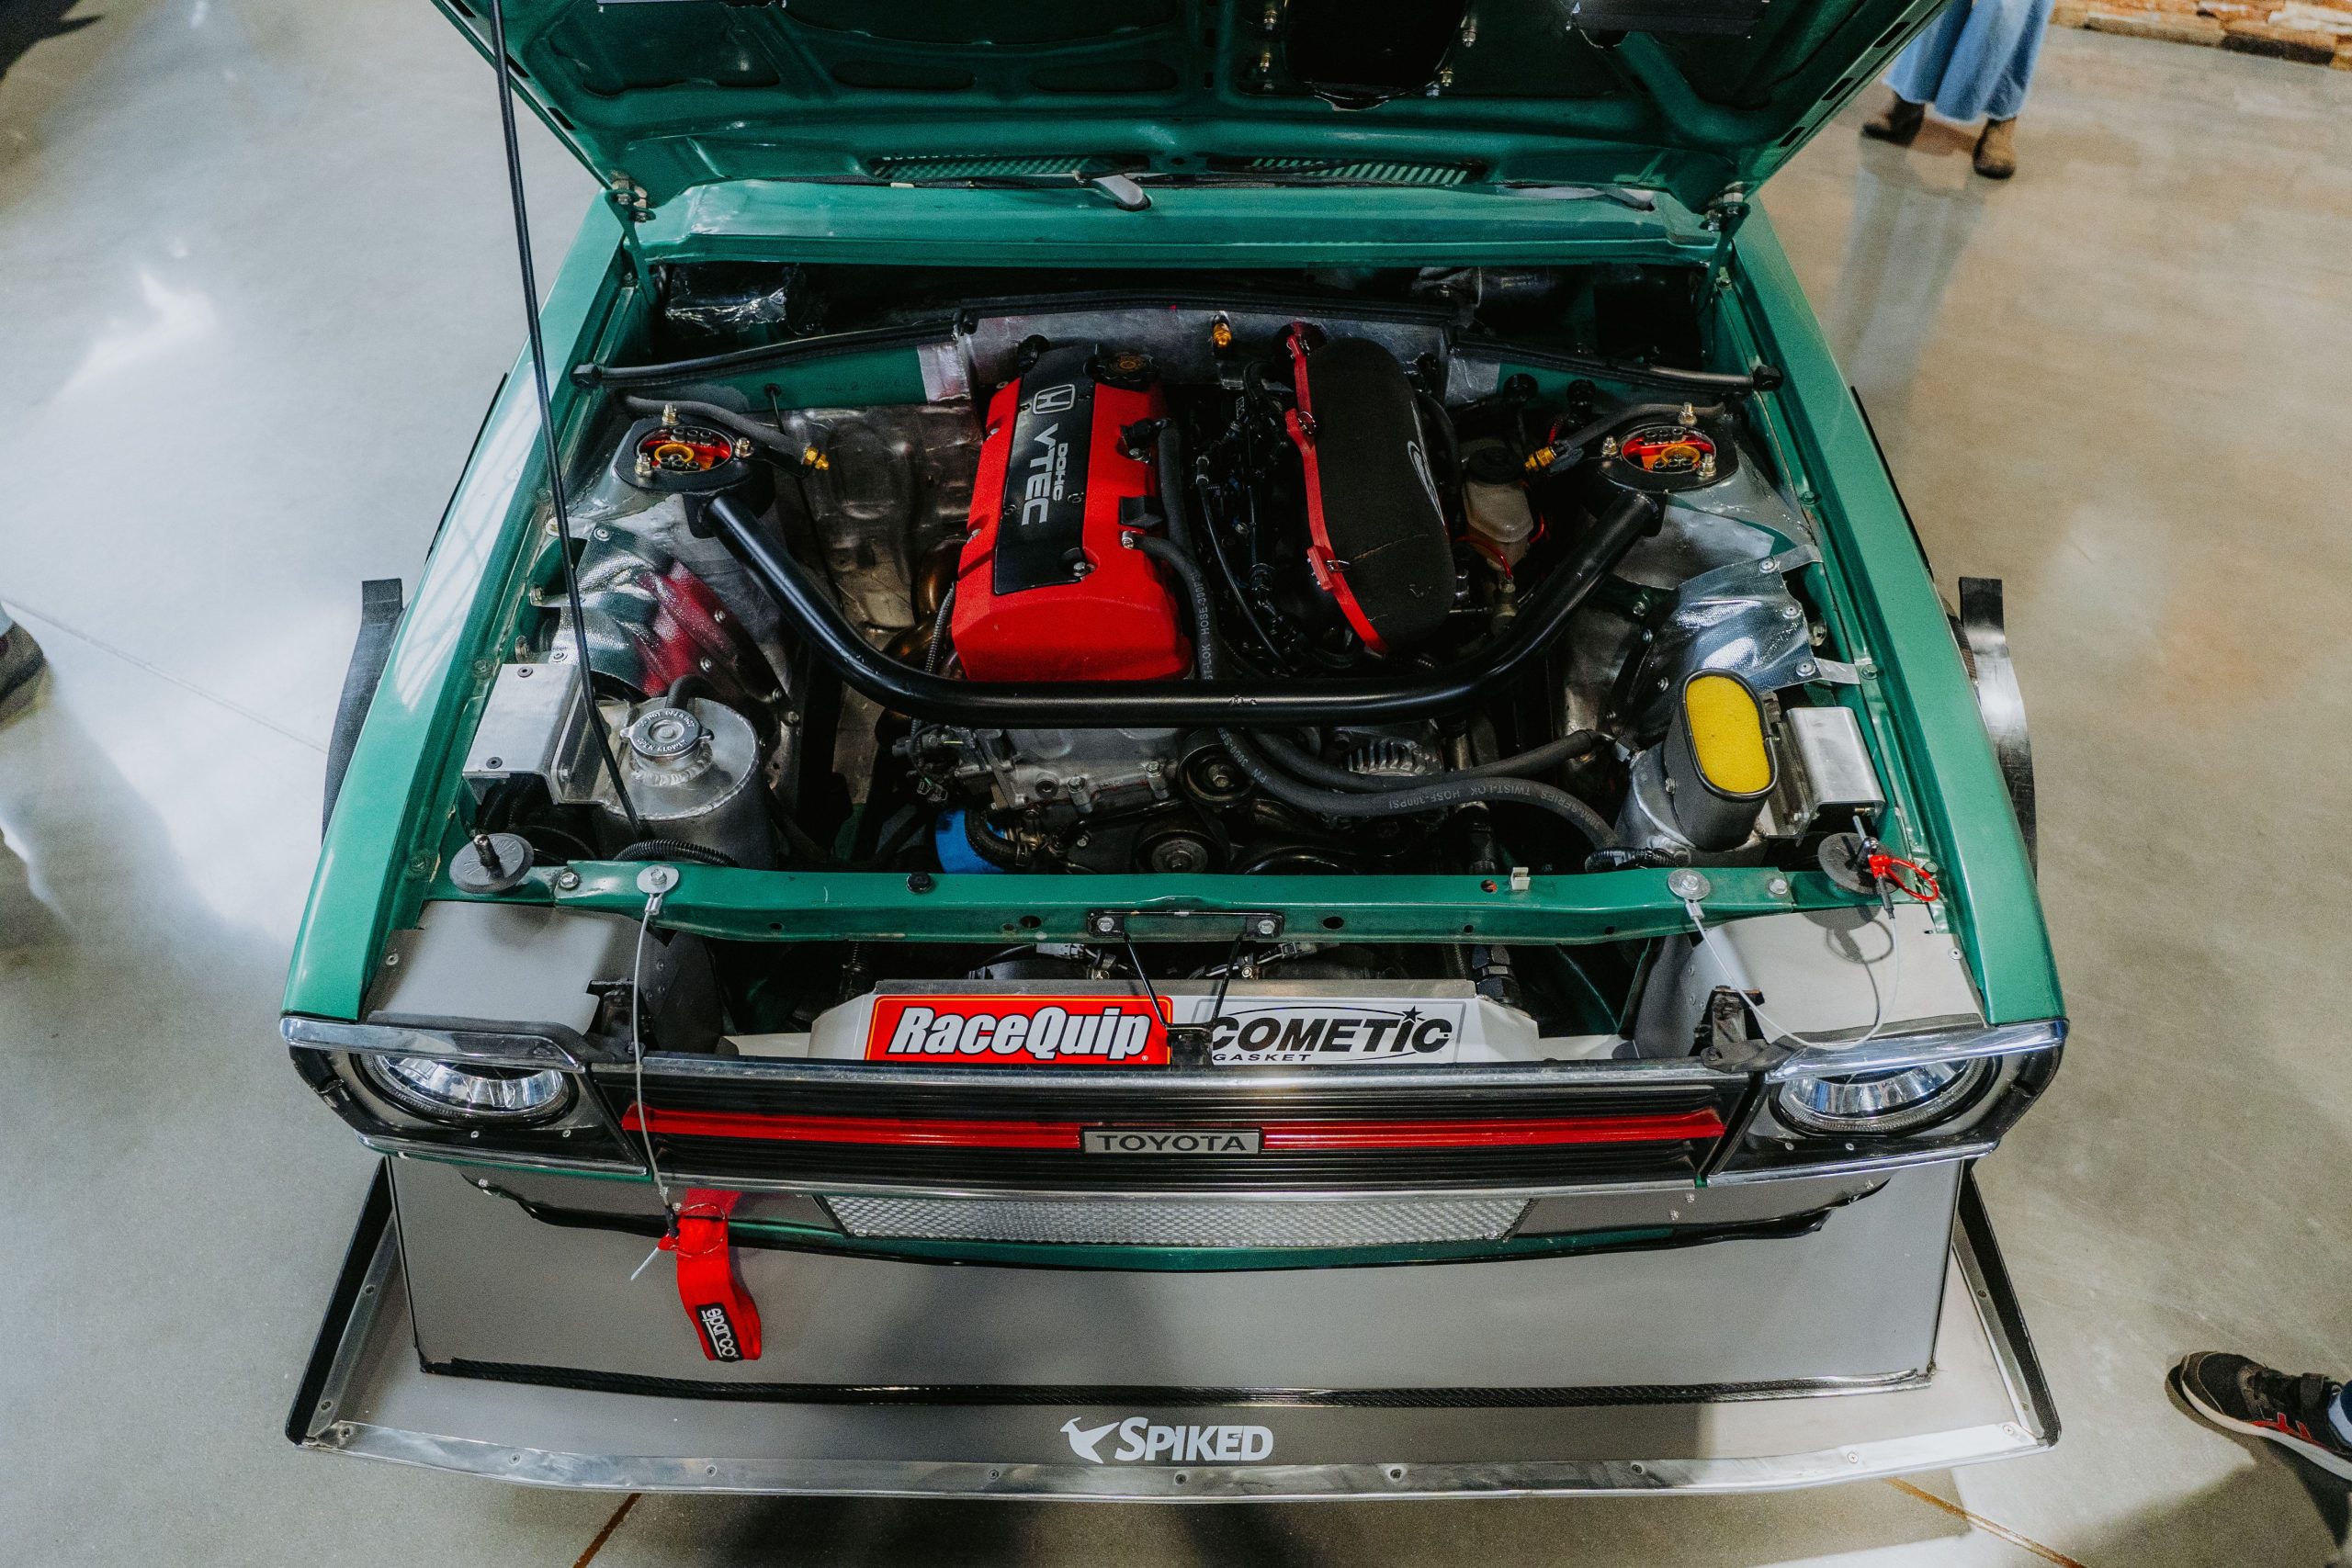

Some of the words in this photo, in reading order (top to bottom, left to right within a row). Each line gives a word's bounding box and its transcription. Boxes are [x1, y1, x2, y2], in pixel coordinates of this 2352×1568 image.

[1022, 423, 1058, 525] VTEC
[1053, 443, 1069, 501] DOHC
[1202, 643, 1213, 680] ST-LOK
[637, 737, 656, 750] OPEN
[886, 1006, 1150, 1060] RaceQuip
[1212, 1016, 1453, 1054] COMETIC
[1212, 1054, 1312, 1062] GASKET
[1096, 1134, 1247, 1152] TOYOTA
[701, 1308, 736, 1357] sparco
